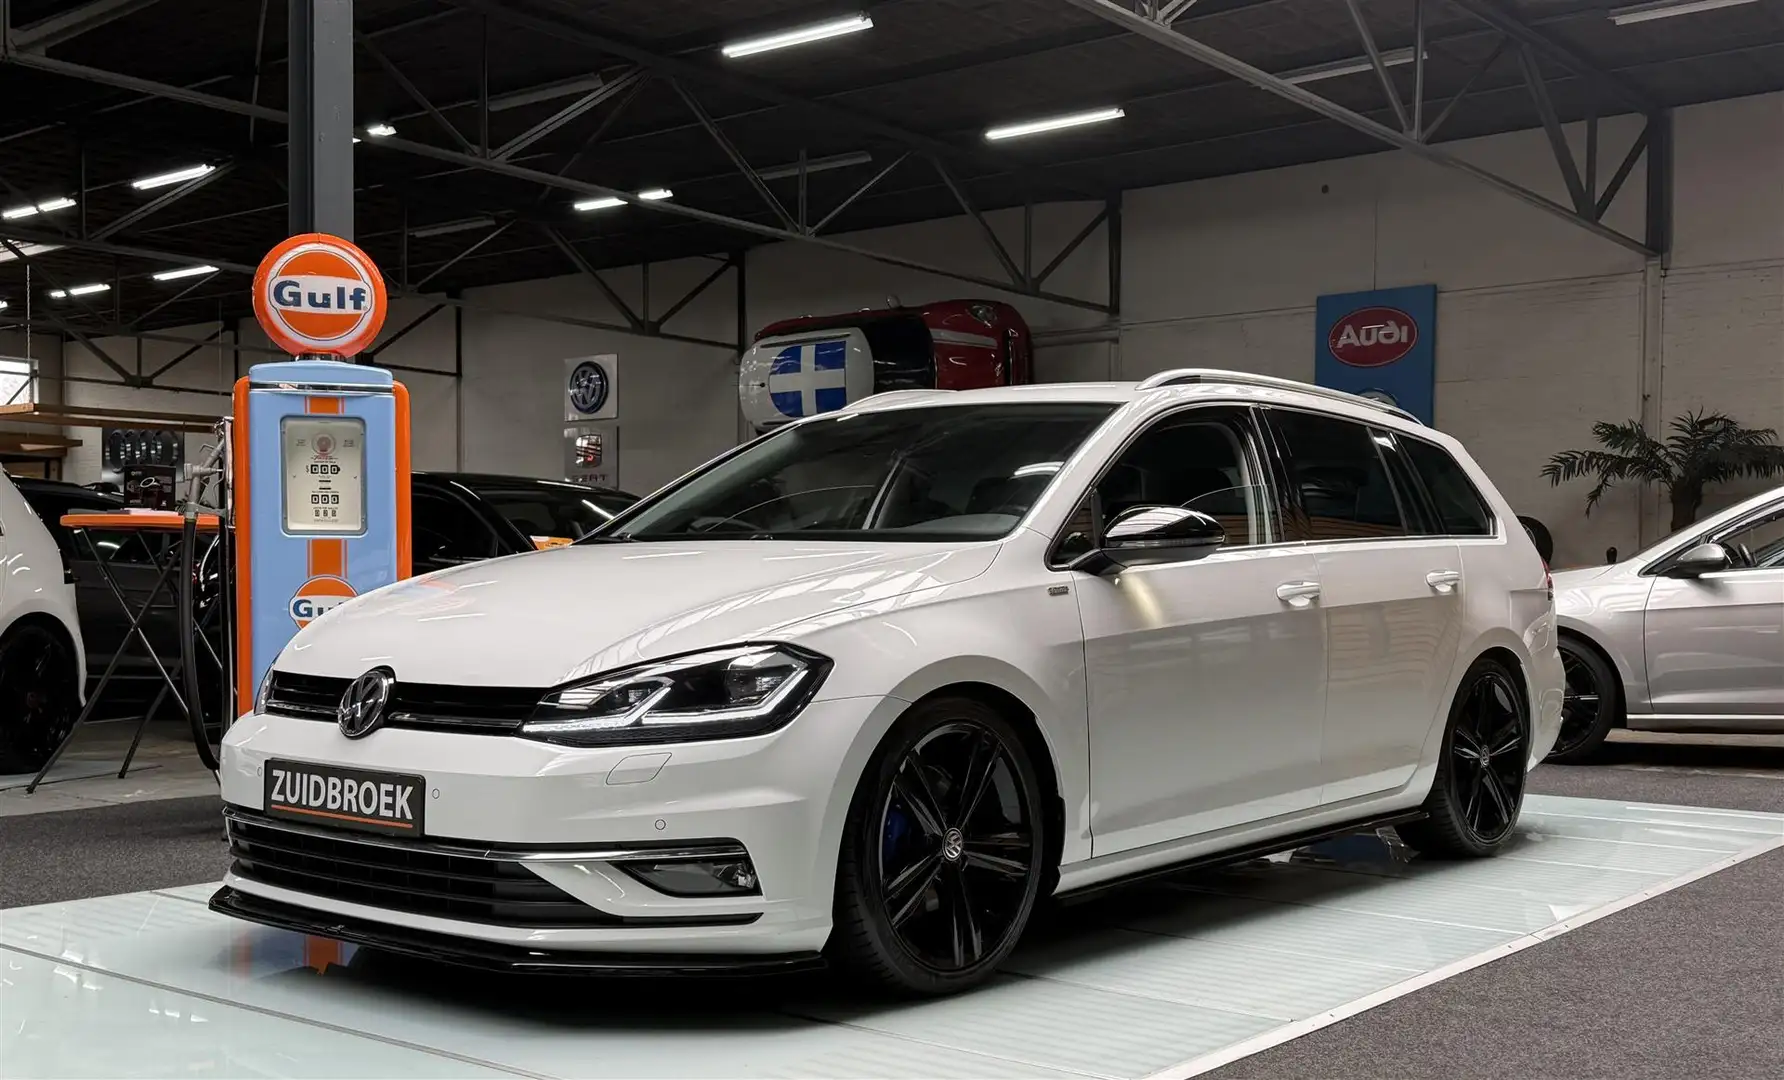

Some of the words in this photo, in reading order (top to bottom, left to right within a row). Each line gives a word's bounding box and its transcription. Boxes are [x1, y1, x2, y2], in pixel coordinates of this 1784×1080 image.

[273, 280, 366, 310] Gulf
[1336, 320, 1409, 349] Audi
[271, 769, 414, 820] ZUIDBROEK
